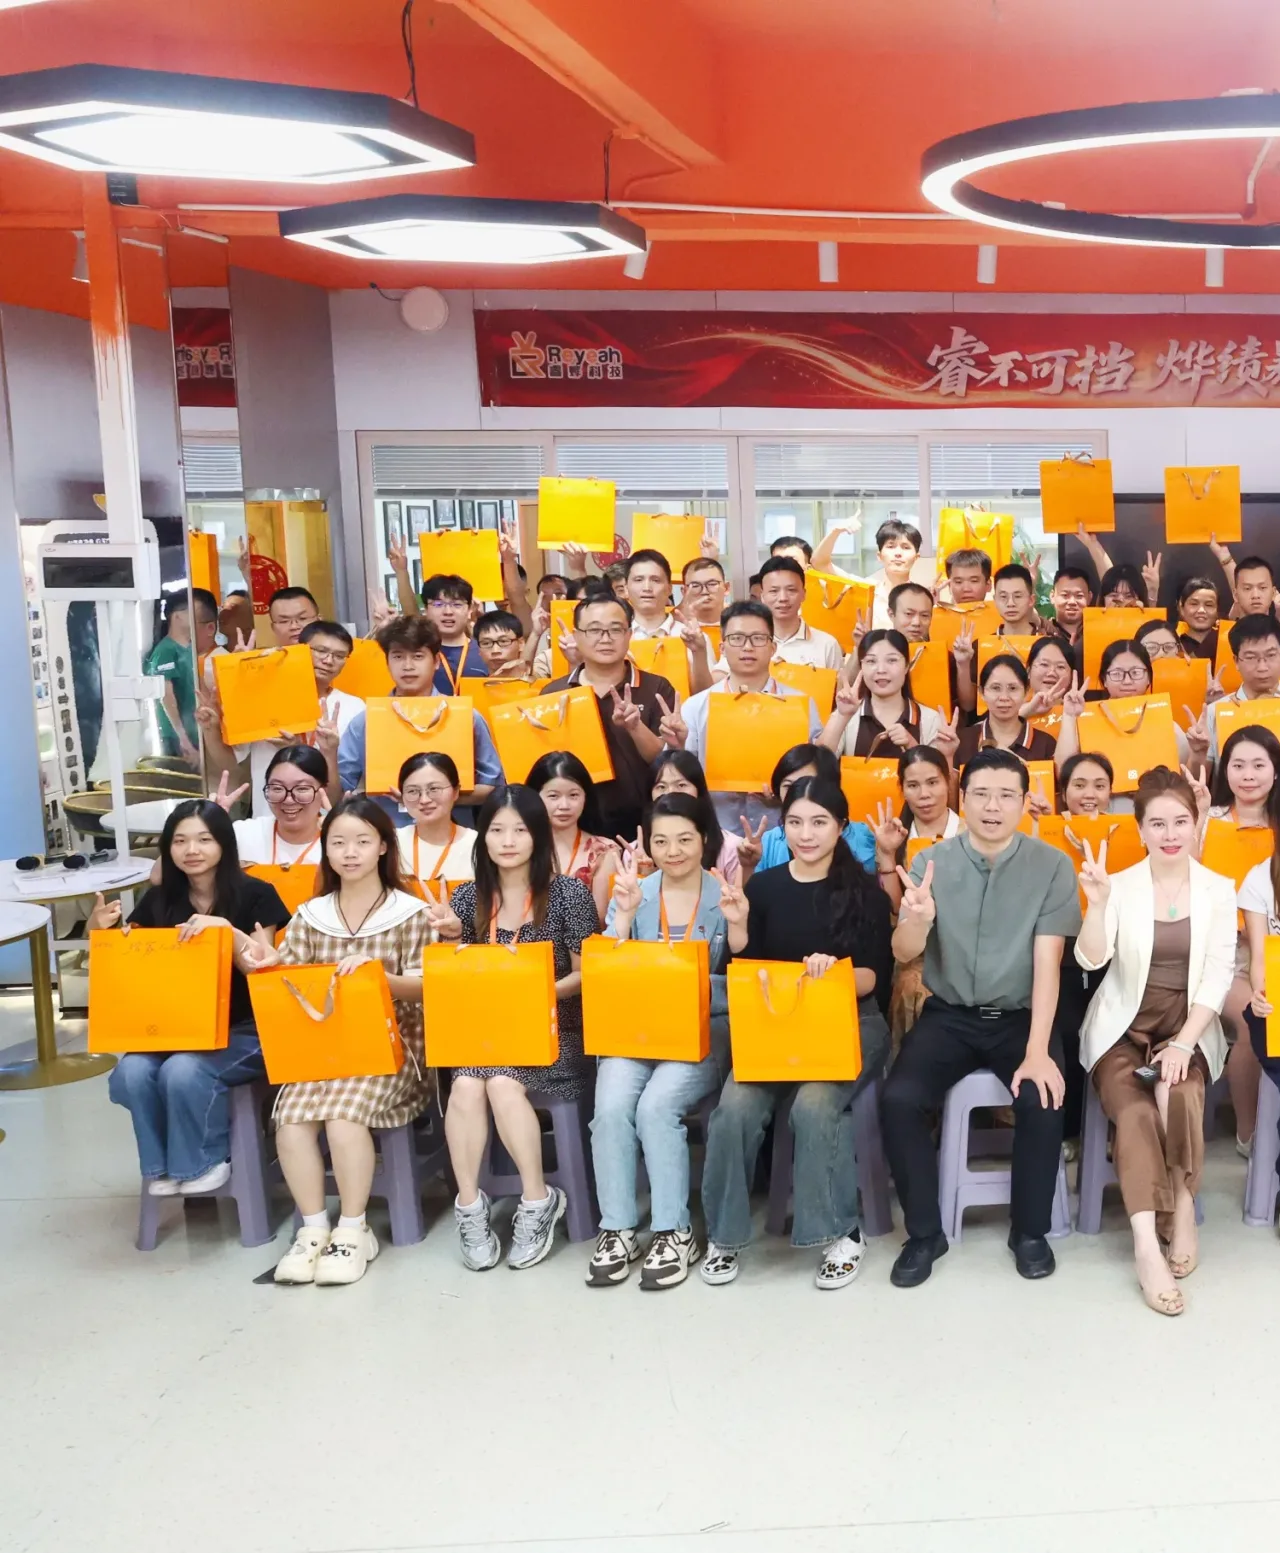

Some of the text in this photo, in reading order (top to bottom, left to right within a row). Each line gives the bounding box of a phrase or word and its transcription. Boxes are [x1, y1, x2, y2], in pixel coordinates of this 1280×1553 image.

[547, 345, 622, 364] Reyeah
[914, 326, 1134, 397] 睿不可挡
